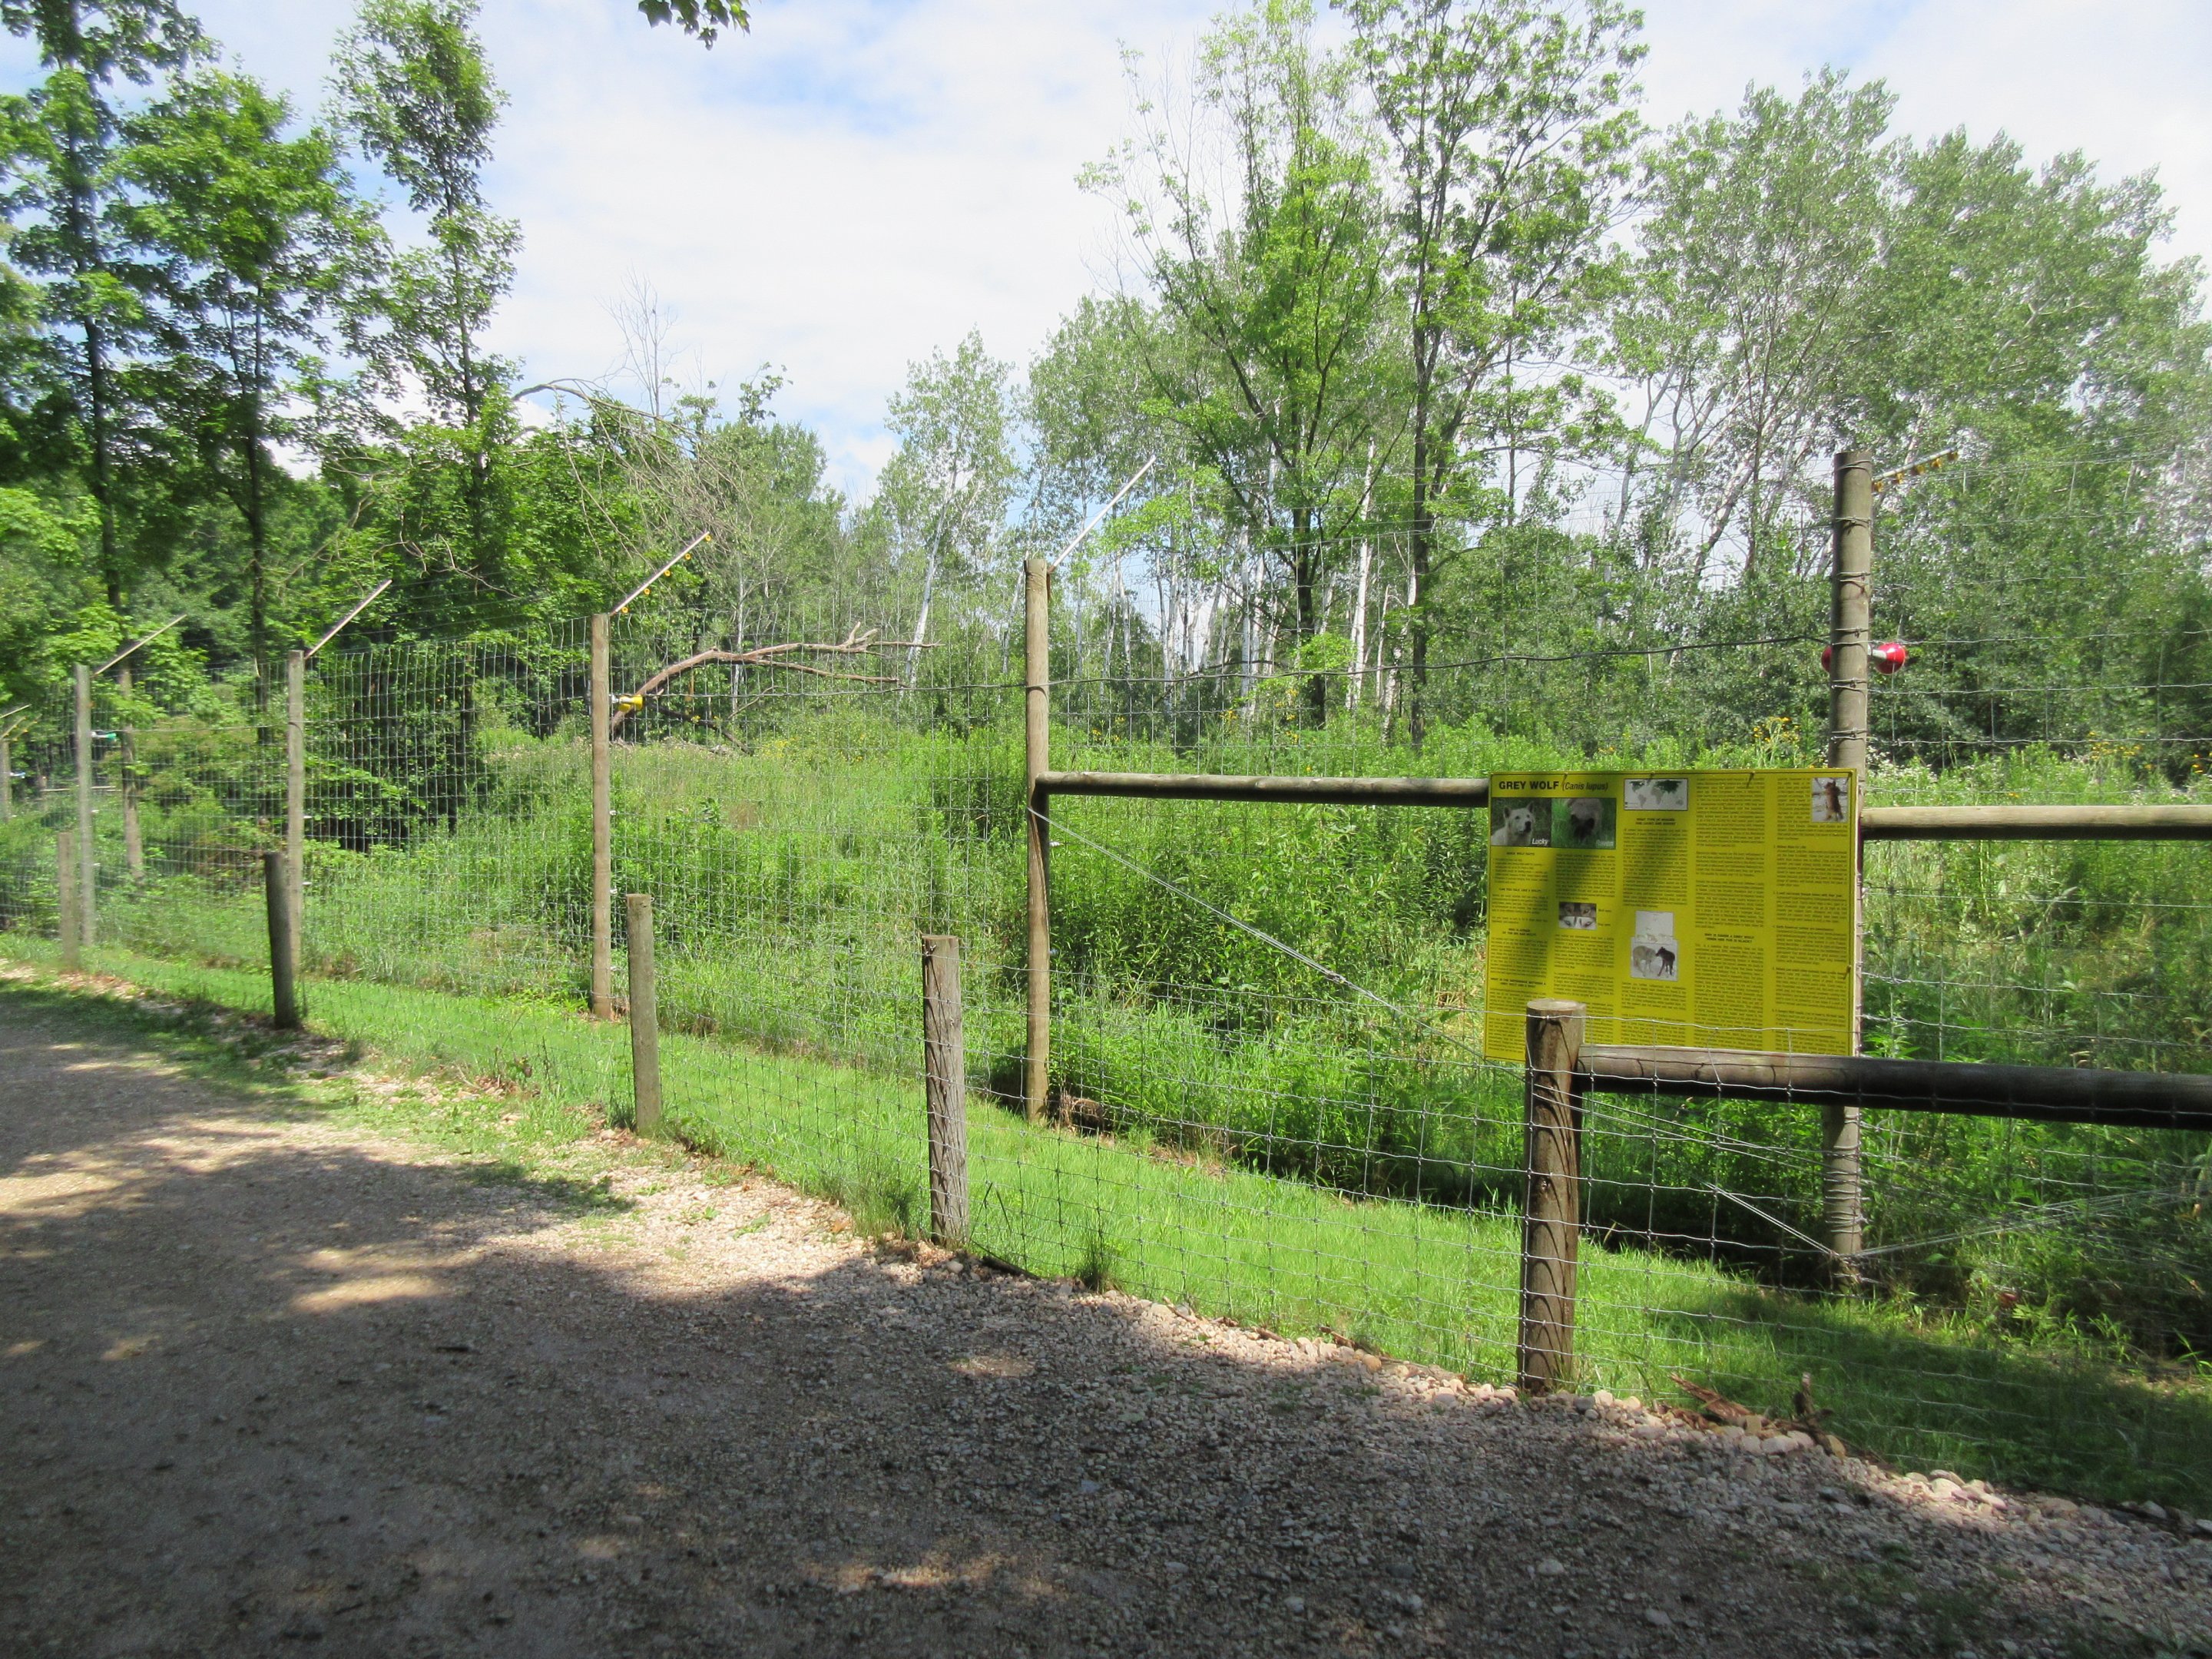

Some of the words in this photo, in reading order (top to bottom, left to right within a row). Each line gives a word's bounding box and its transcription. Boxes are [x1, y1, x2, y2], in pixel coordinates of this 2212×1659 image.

[1498, 781, 1526, 790] GREY
[1530, 781, 1559, 790] WOLF
[1562, 782, 1584, 791] (Canis
[1586, 783, 1608, 792] lupus)
[1532, 838, 1549, 846] Lucky
